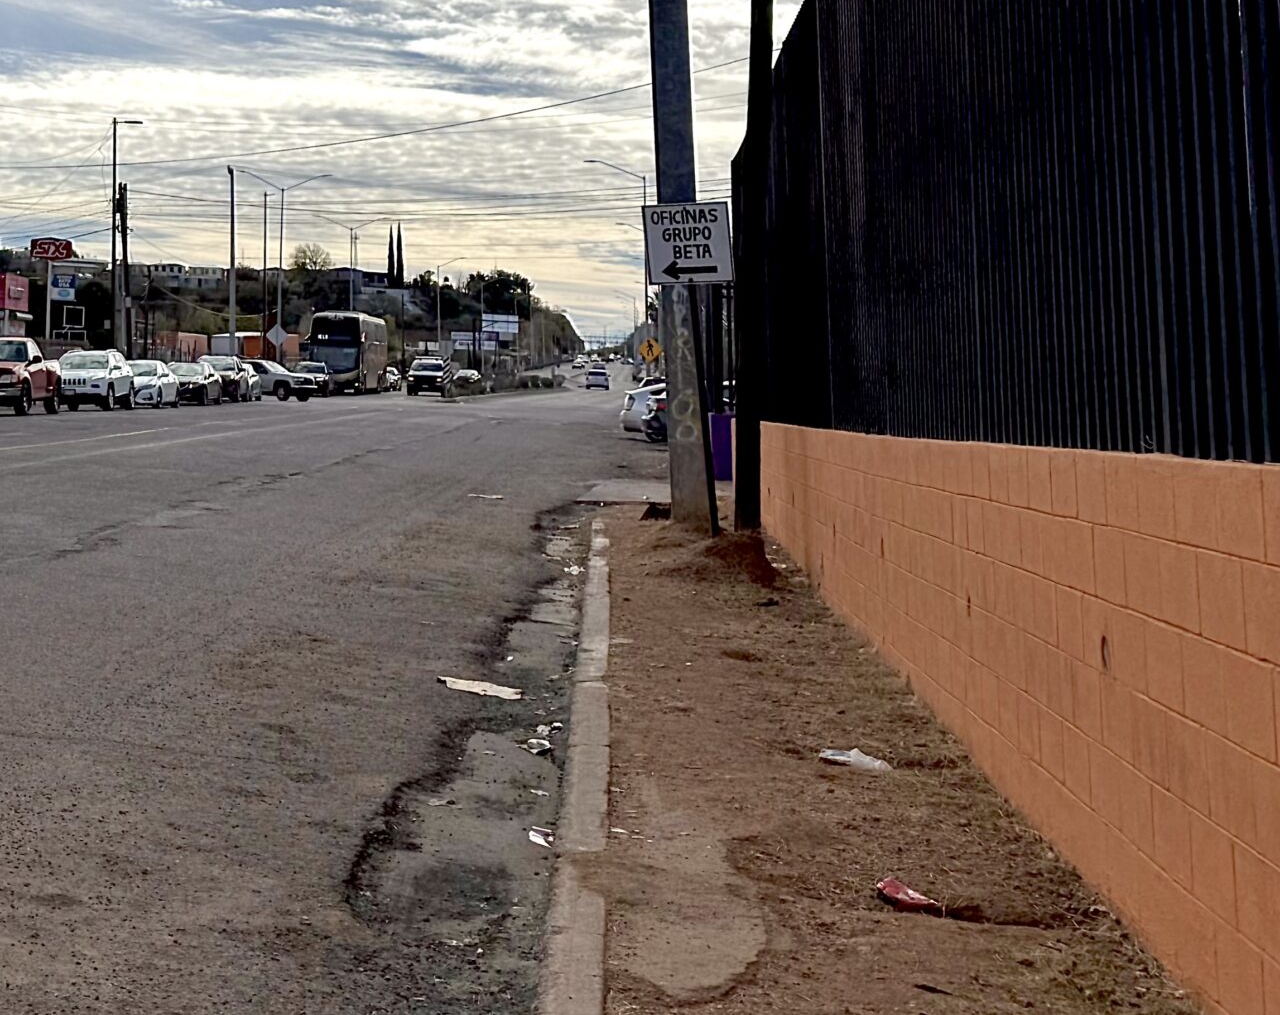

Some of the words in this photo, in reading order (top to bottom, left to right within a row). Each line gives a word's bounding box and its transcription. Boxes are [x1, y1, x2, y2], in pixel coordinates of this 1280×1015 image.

[650, 207, 718, 226] OFICINAS
[662, 225, 712, 243] GRUPO
[32, 239, 67, 258] SIX
[673, 243, 713, 260] BETA
